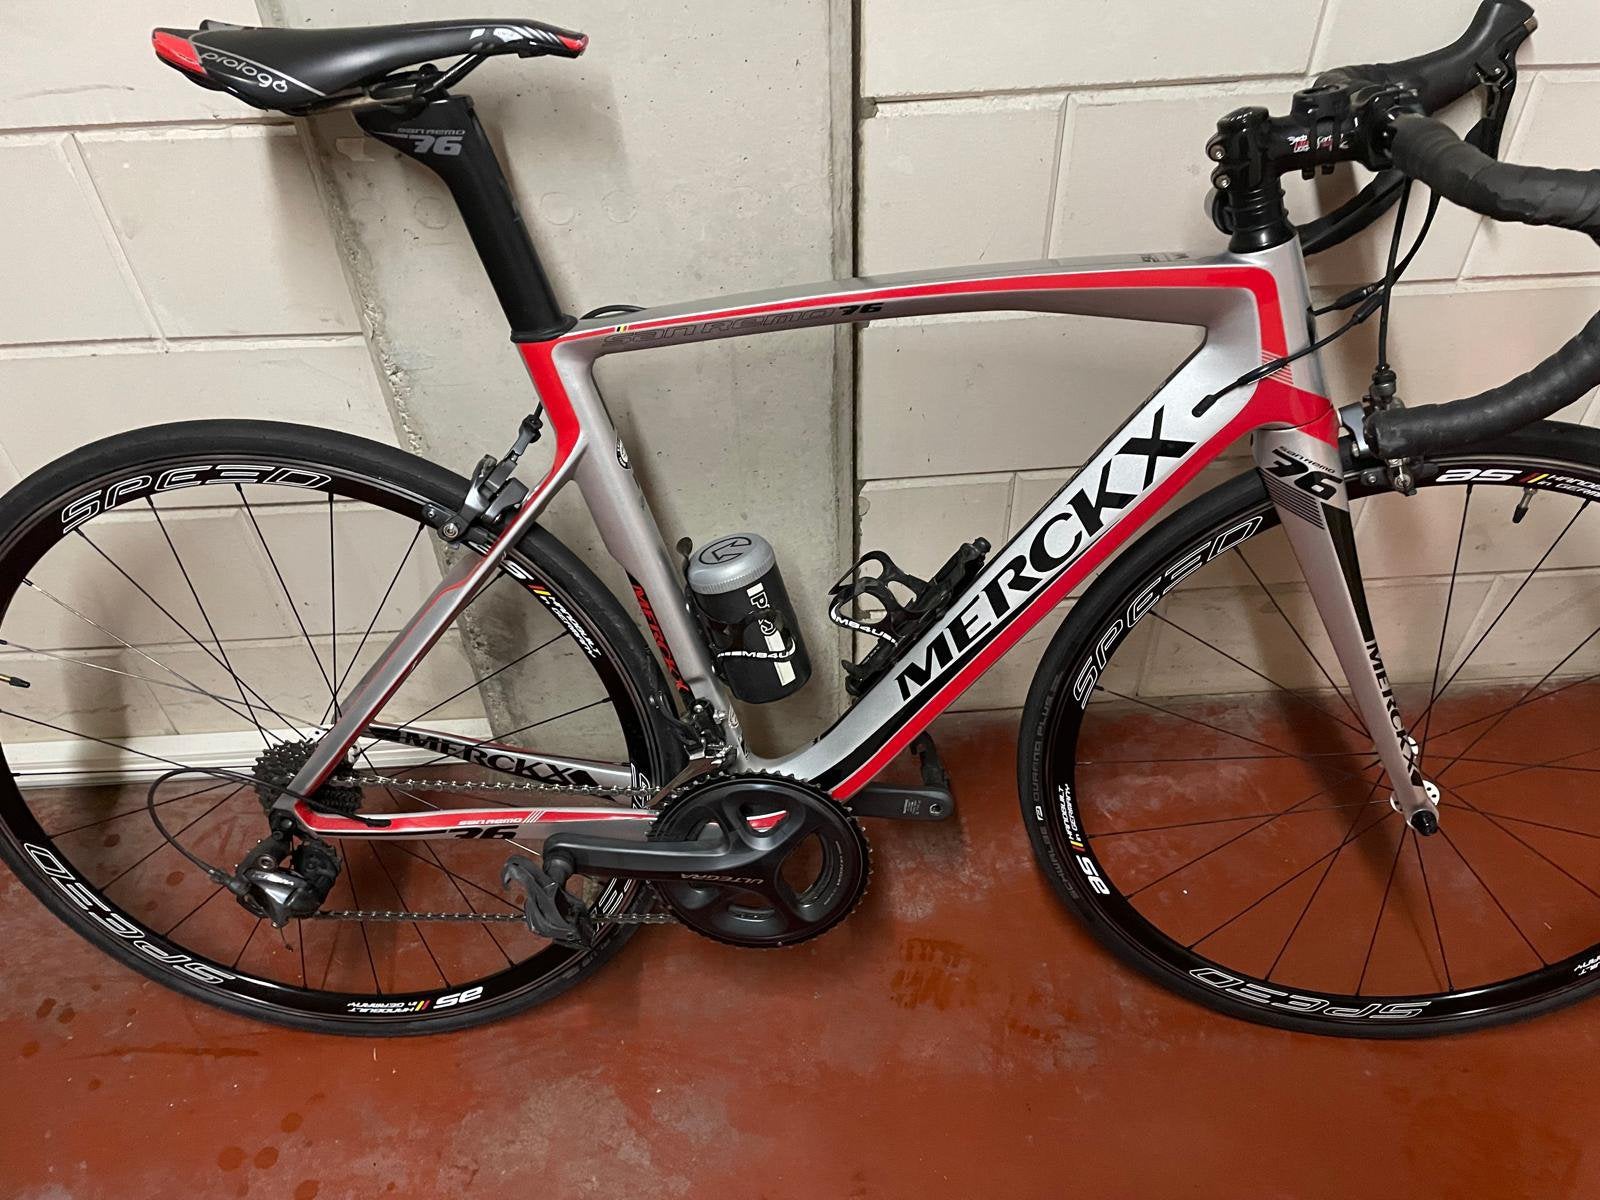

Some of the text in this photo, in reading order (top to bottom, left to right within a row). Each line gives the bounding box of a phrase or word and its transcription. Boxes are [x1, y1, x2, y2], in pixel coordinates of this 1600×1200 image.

[202, 50, 288, 94] prologo
[413, 135, 464, 156] 76
[838, 302, 884, 317] 76
[60, 466, 332, 533] SPEED
[1265, 448, 1344, 501] 76
[894, 404, 1199, 702] MERCKX
[1072, 516, 1263, 710] SPEED
[1365, 641, 1418, 774] MERCKX
[404, 732, 574, 786] MERCKX
[680, 872, 765, 886] ULTEGRA
[24, 842, 236, 986] SPEED
[1189, 967, 1432, 1020] SPEED
